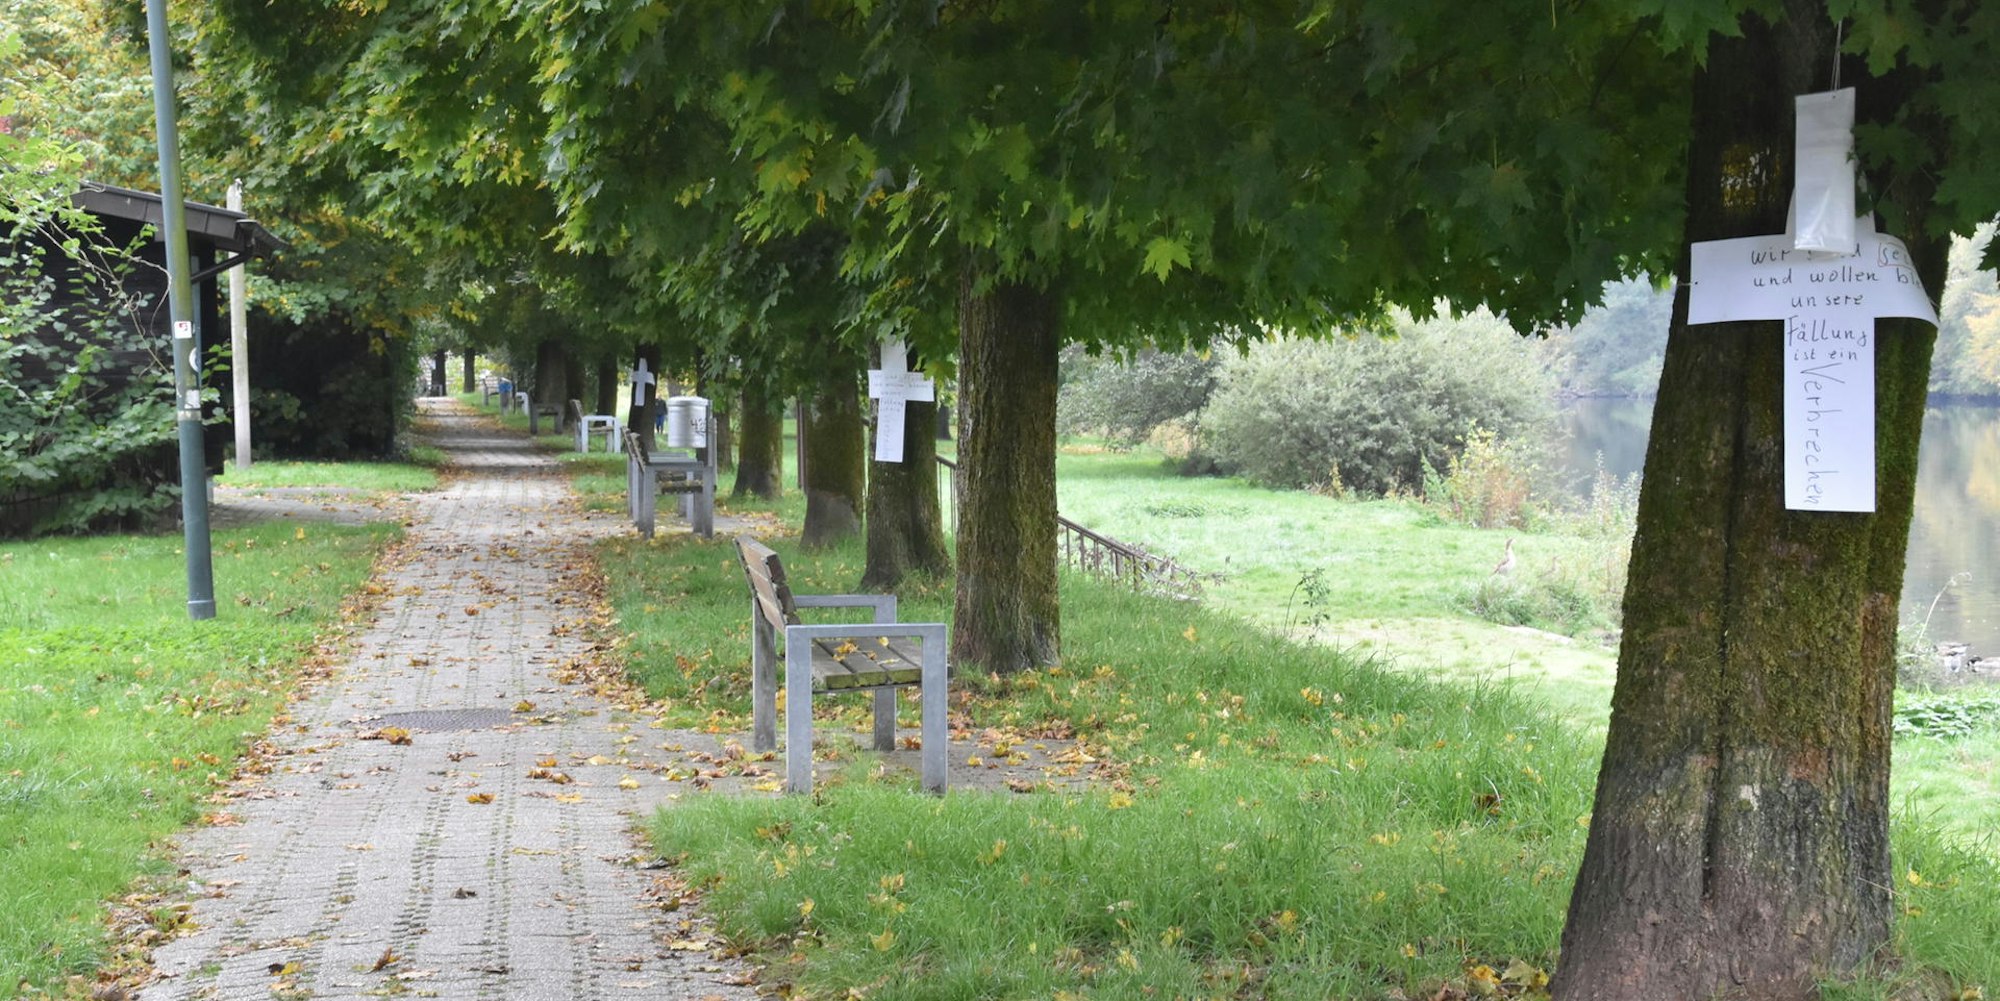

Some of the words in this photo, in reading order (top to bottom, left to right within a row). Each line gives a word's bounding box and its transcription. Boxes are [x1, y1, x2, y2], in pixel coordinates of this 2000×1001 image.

[1751, 246, 1791, 265] wir
[1753, 268, 1792, 287] und
[1809, 266, 1880, 283] wollen
[1787, 315, 1868, 347] Fällung
[1793, 348, 1816, 361] ist
[1828, 348, 1858, 361] ein
[1800, 362, 1846, 505] Verbrechen
